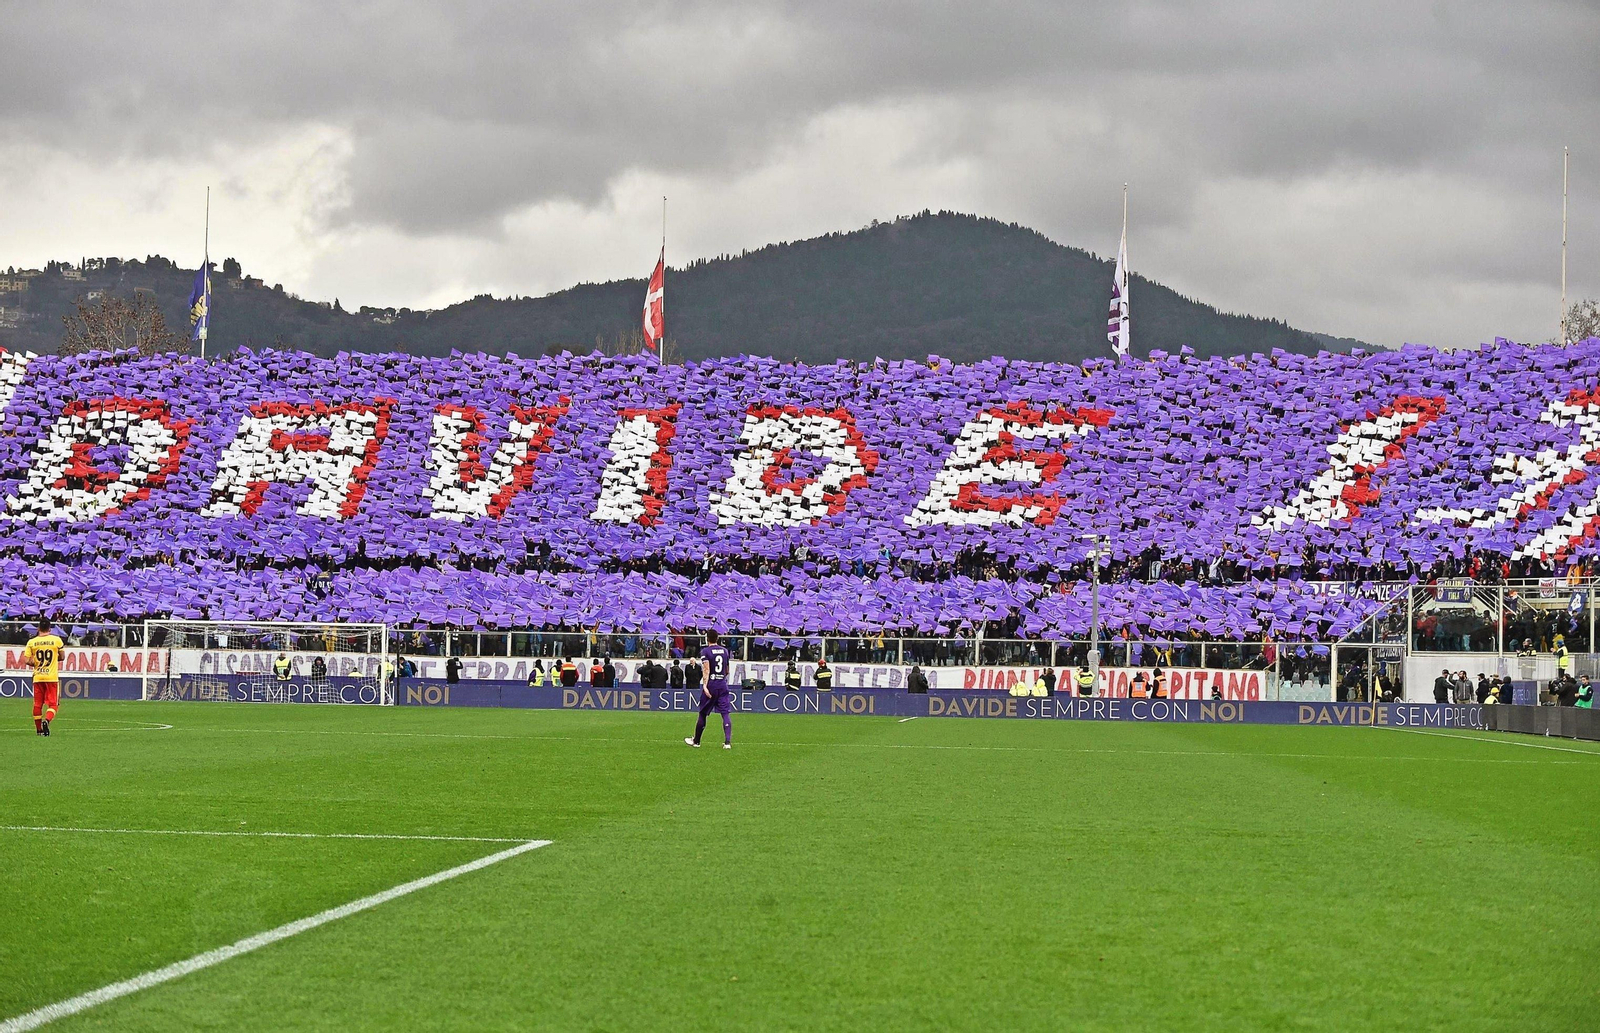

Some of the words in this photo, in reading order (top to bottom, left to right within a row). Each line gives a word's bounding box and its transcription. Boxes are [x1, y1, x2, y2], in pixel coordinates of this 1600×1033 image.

[5, 396, 1115, 527] DAVIDE
[36, 649, 53, 667] 99
[715, 655, 723, 673] 3
[58, 680, 89, 698] OI
[146, 680, 229, 700] DAVIDE
[236, 682, 330, 703] SEMPRE
[406, 685, 450, 704] NOI
[562, 689, 650, 709] DAVIDE
[658, 691, 753, 711] SEMRE
[763, 692, 819, 712] CON
[831, 695, 875, 714] NOI
[928, 697, 1018, 717] DAVIDE
[1025, 699, 1121, 719] SEMPRE
[1131, 701, 1188, 721] CON
[1200, 702, 1244, 721] NOI
[1299, 705, 1389, 725] DAVIDE
[1395, 706, 1466, 727] SEMPRE
